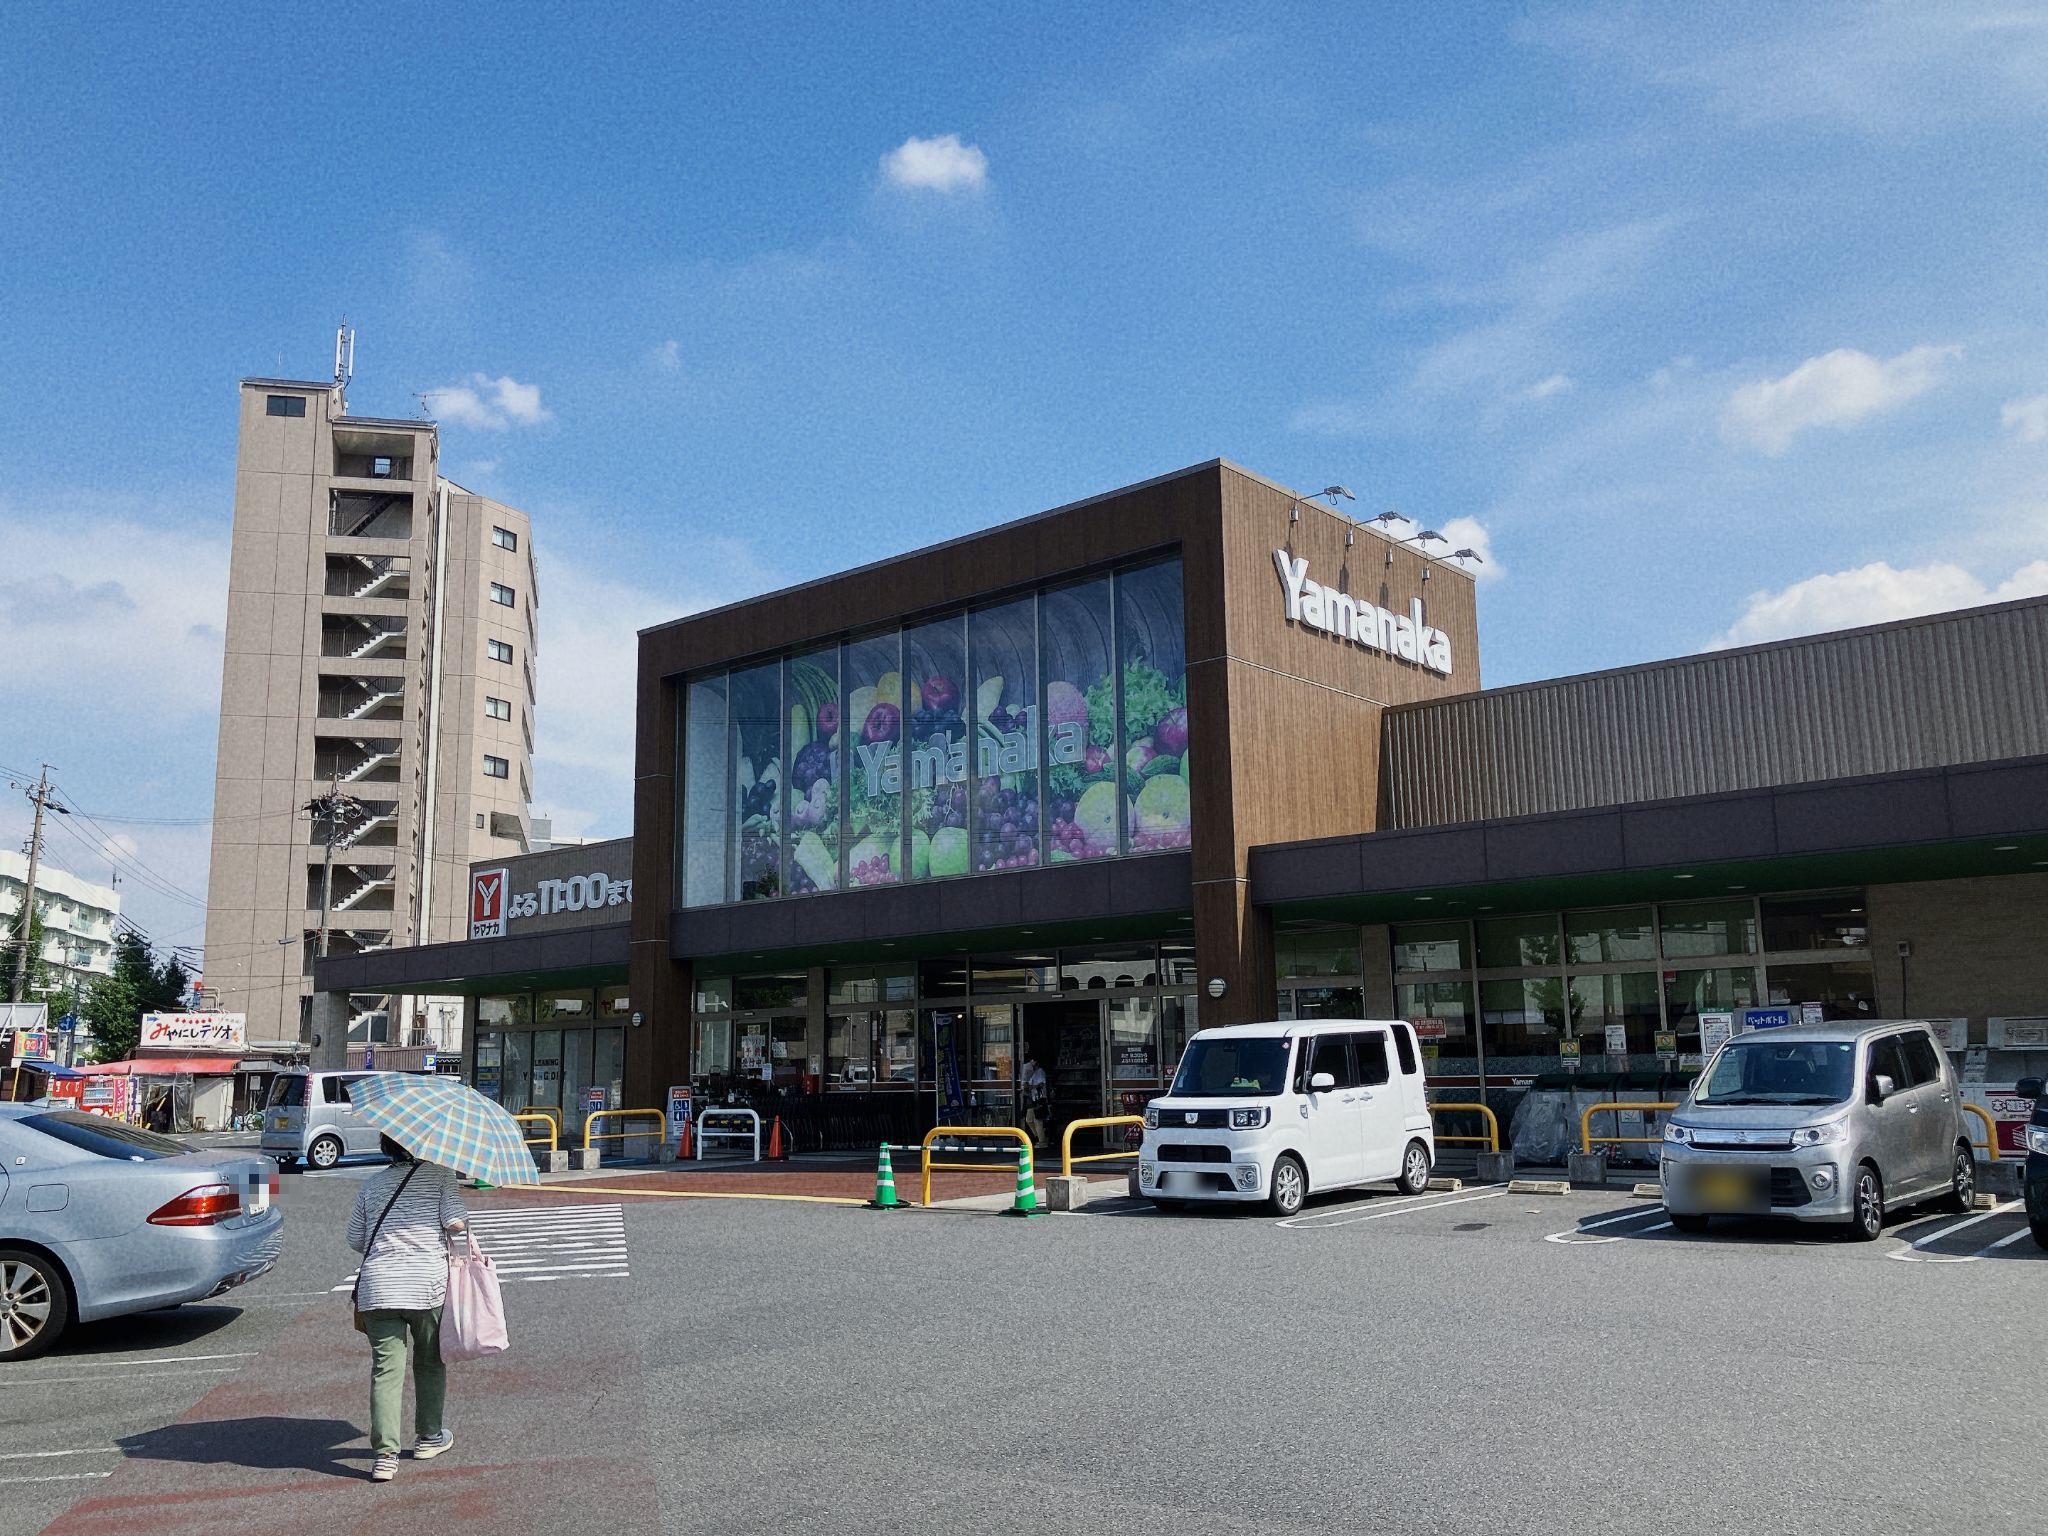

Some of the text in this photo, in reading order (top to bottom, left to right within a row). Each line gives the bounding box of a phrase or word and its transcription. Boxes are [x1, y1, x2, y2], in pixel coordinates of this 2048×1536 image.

[1272, 549, 1453, 675] Yamanaka
[856, 704, 1084, 797] Yamanaka
[477, 877, 500, 917] Y
[473, 921, 500, 938] ヤマナカ
[1747, 1015, 1787, 1026] ペットボトル
[1511, 1077, 1535, 1086] Yaman
